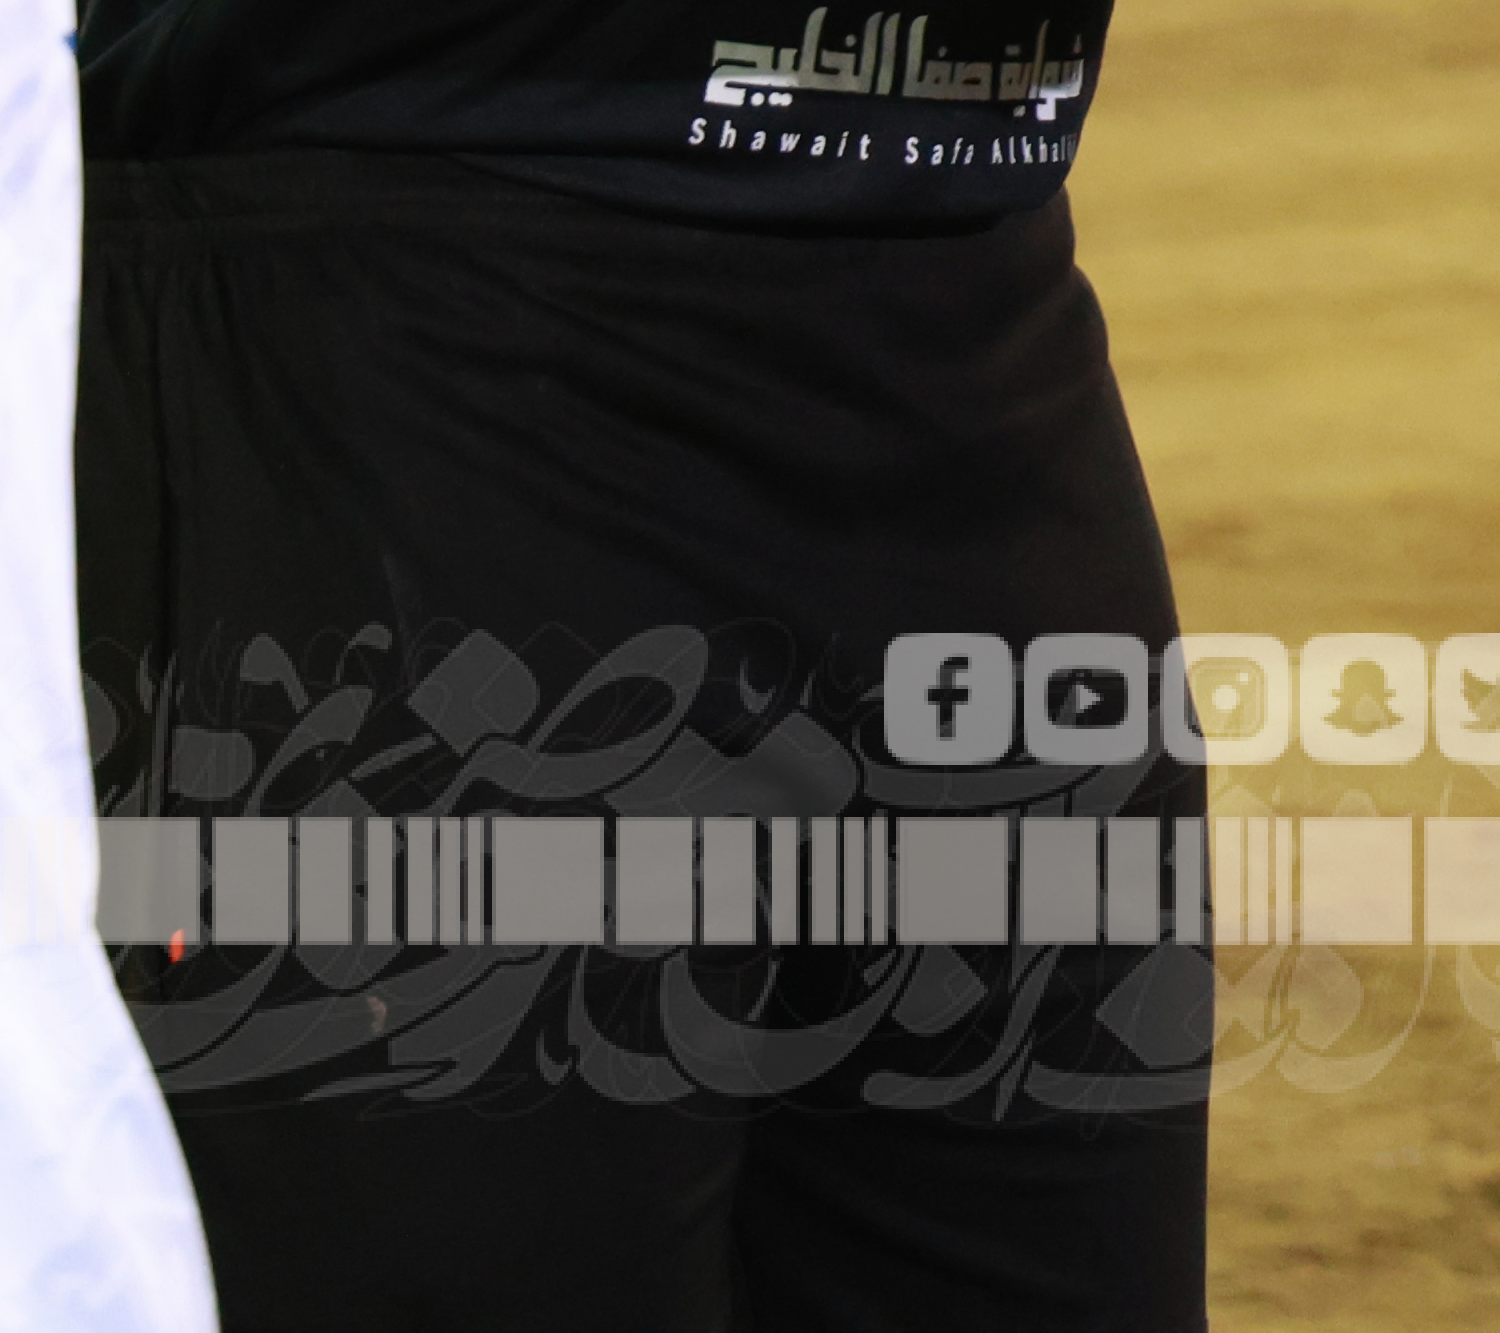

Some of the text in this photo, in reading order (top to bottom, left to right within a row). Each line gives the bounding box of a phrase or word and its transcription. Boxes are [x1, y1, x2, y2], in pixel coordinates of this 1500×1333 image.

[703, 6, 900, 107] الخليج
[901, 14, 994, 101] صفا
[688, 117, 872, 161] Shawait
